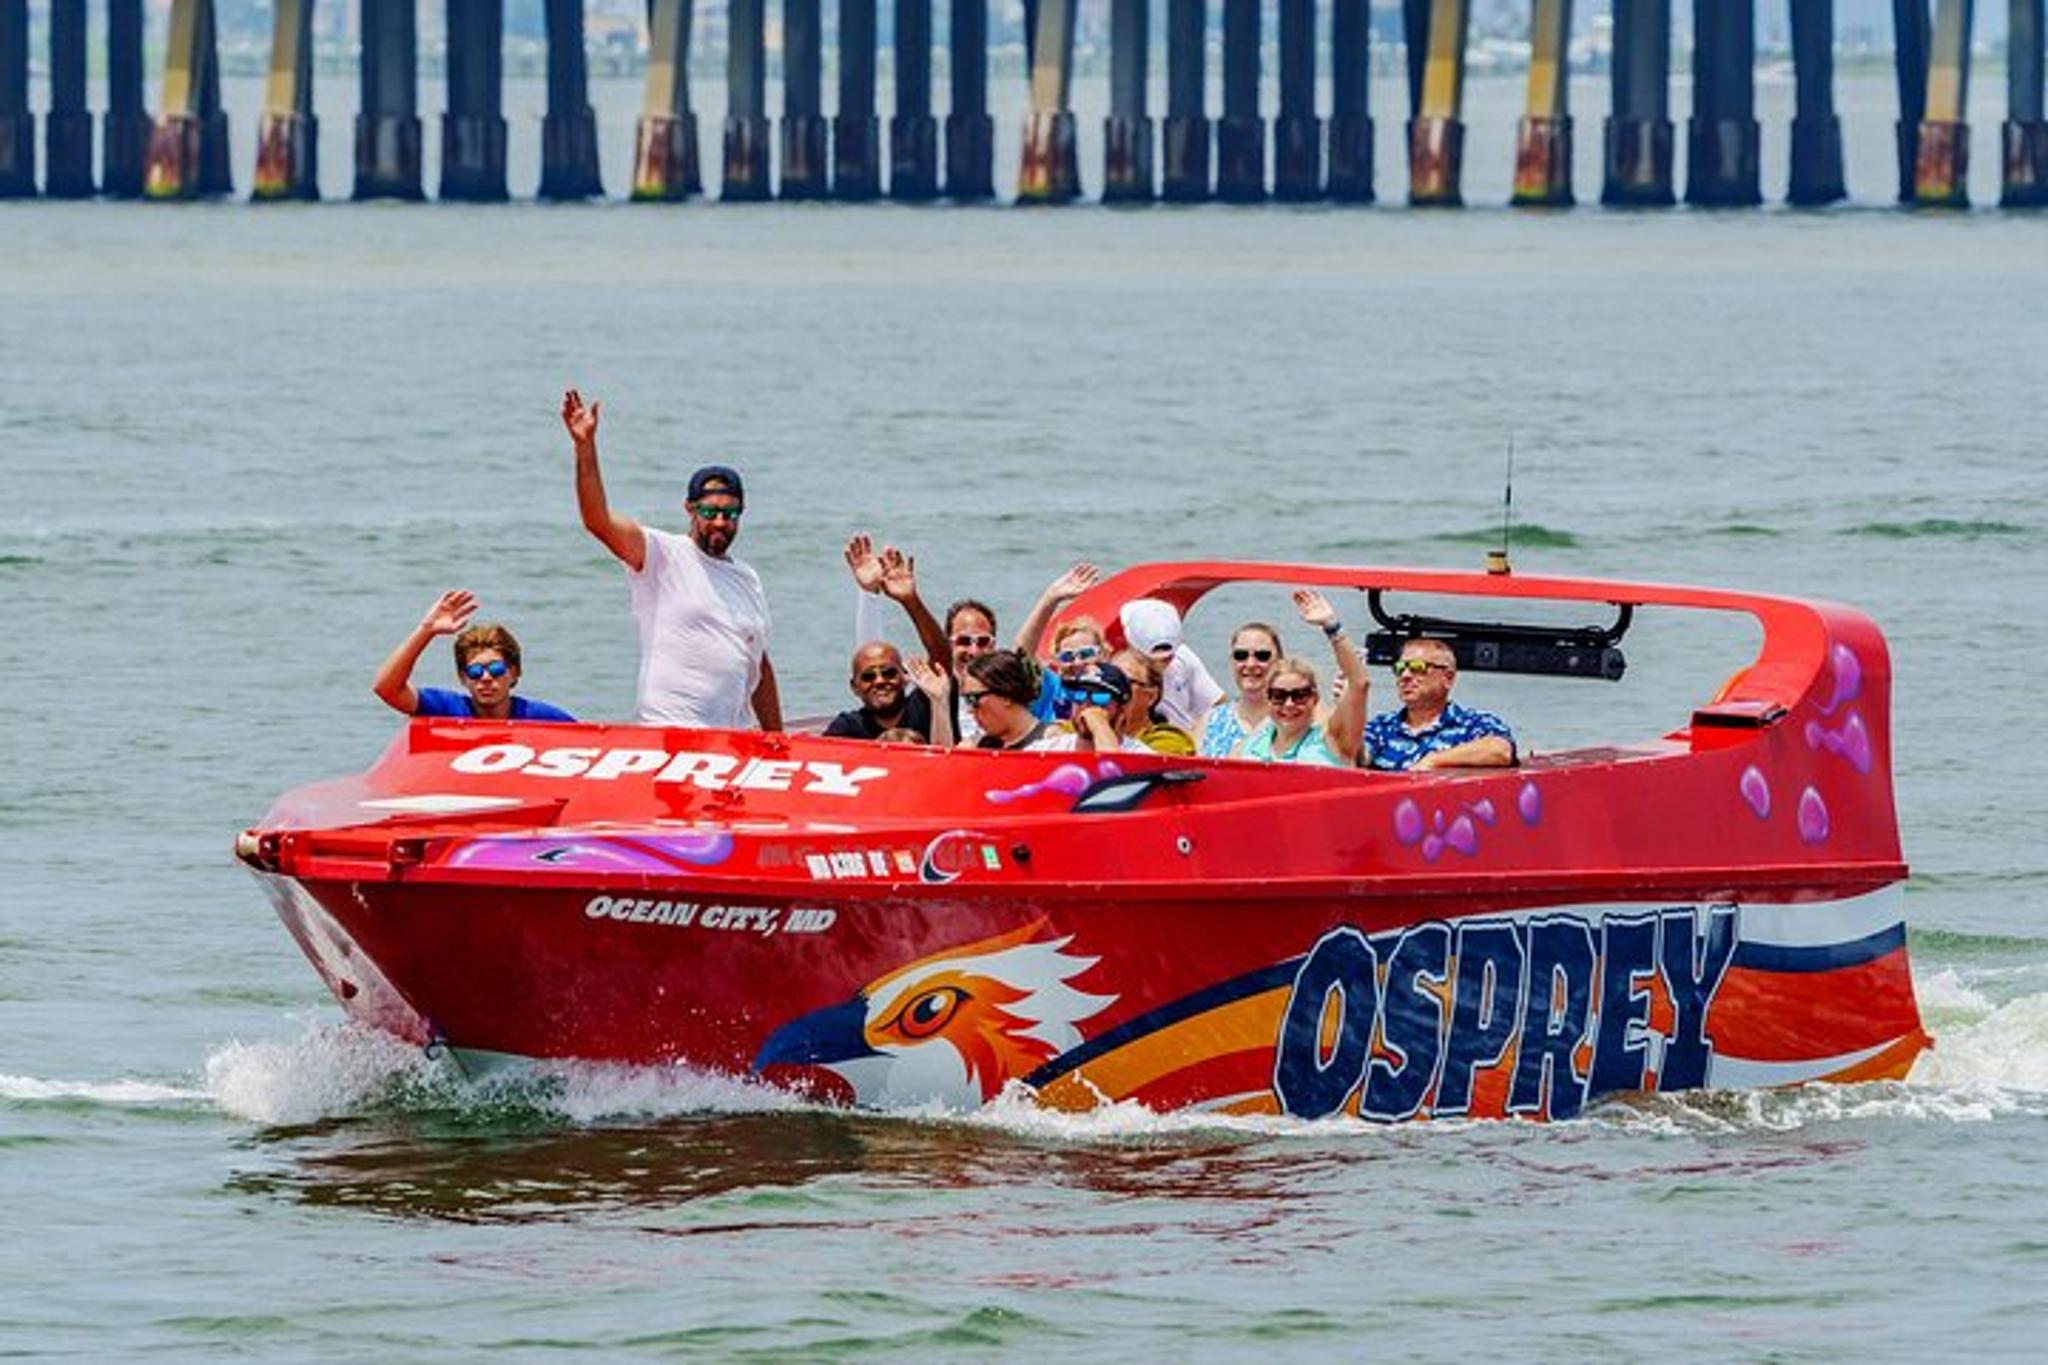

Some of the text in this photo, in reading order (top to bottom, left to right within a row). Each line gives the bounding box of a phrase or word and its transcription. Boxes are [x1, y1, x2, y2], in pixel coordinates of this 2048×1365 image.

[450, 744, 888, 796] OSPREY
[585, 896, 837, 937] OCEAN CITY, MD
[1274, 905, 1738, 1122] OSPREY
